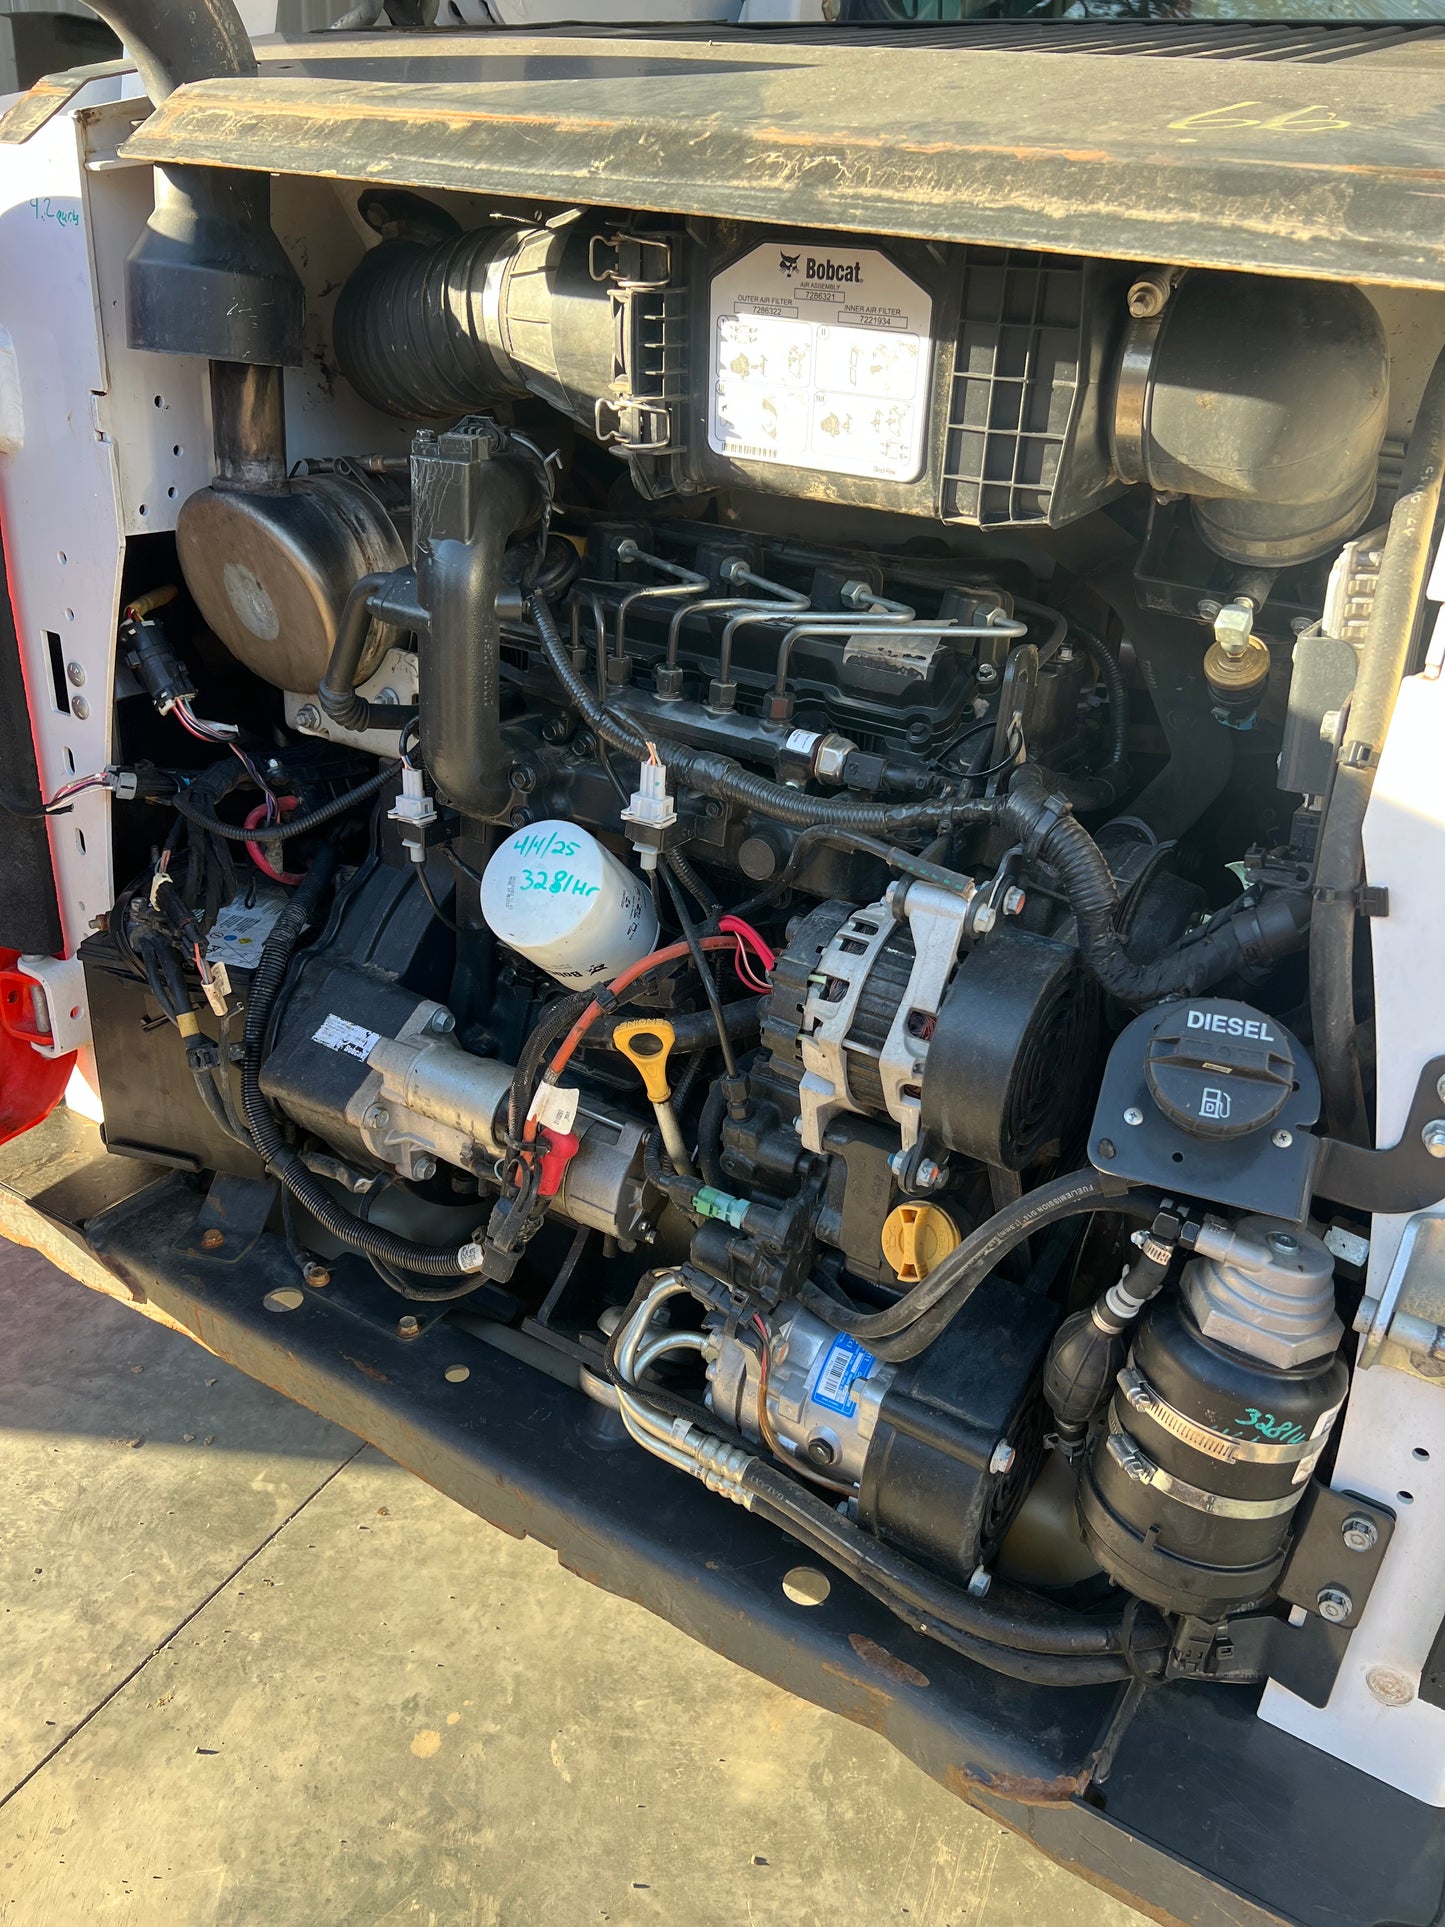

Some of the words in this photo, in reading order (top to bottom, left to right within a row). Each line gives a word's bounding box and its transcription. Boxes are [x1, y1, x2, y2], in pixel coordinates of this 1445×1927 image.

[806, 257, 862, 283] Bobcat
[811, 283, 841, 291] ASSEMBLY
[737, 295, 759, 303] OUTER
[771, 297, 793, 306] FILTER
[805, 291, 836, 301] 7286321
[753, 305, 782, 316] 7286322
[844, 304, 865, 313] INNER
[866, 306, 877, 314] AIR
[878, 307, 902, 316] FILTER
[860, 315, 891, 326] 7221934
[512, 831, 582, 859] 4/4/25
[1187, 1010, 1275, 1042] DIESEL
[1037, 1183, 1095, 1213] FUEL/EMISSION
